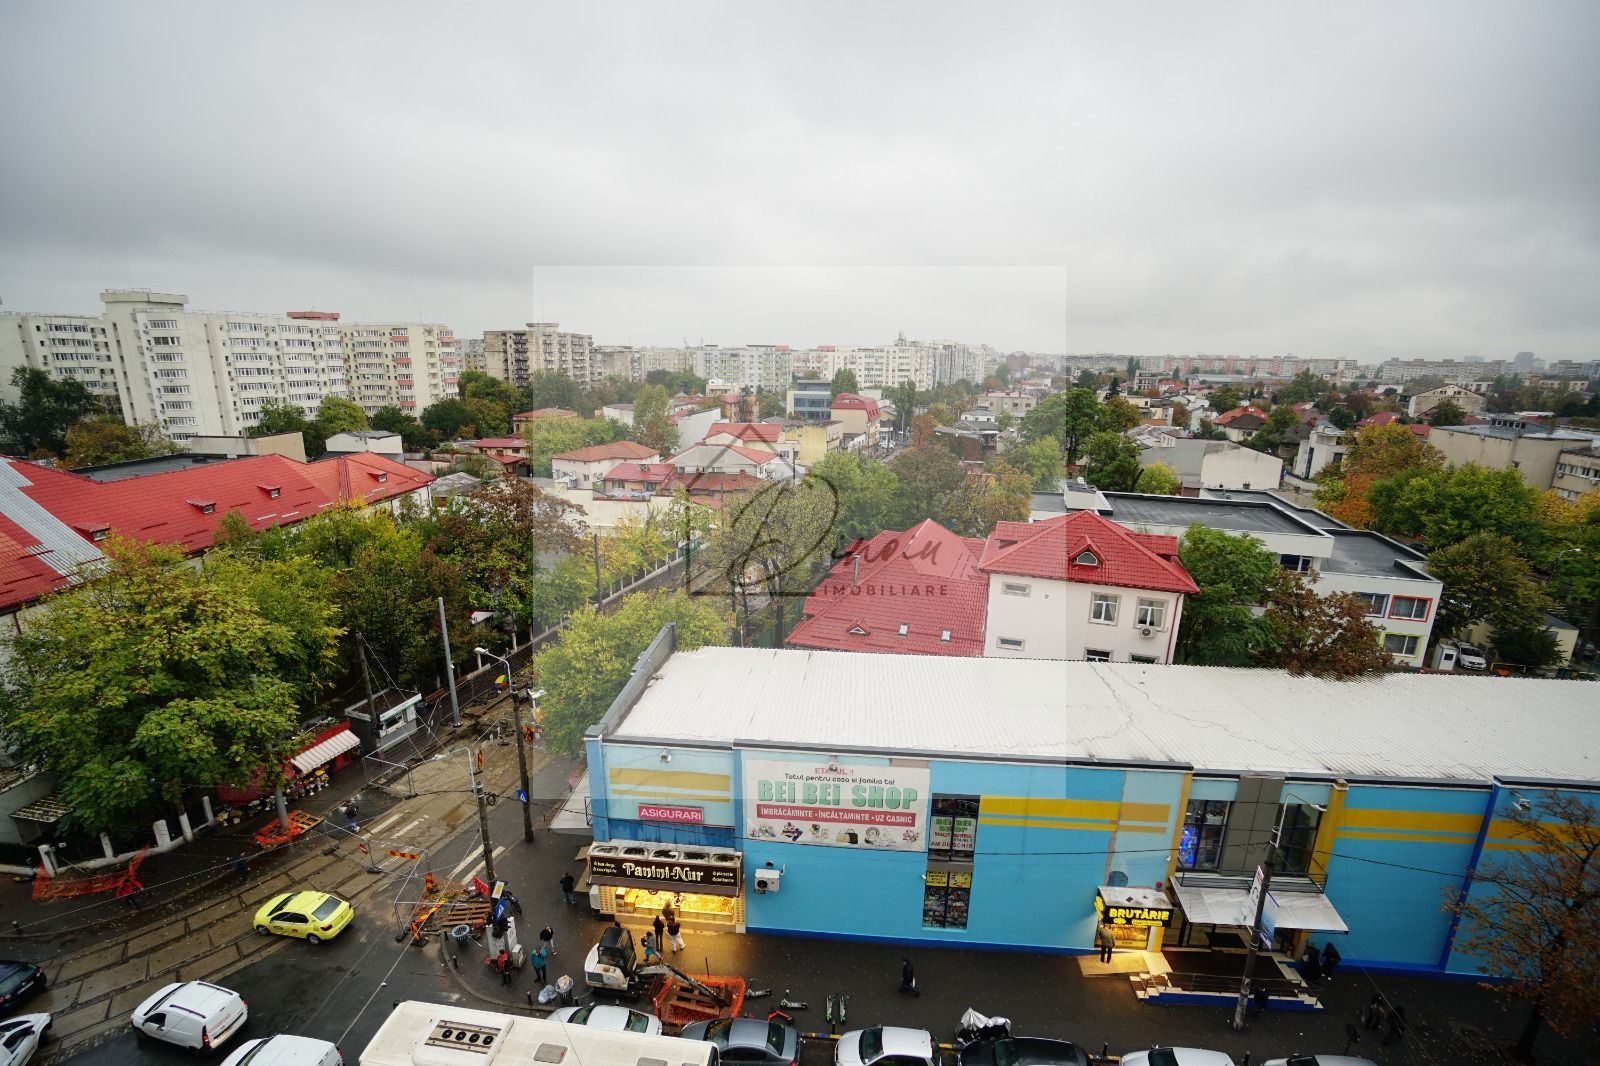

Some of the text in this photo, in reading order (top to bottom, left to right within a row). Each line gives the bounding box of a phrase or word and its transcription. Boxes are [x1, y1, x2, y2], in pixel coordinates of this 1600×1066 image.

[815, 767, 847, 775] ETAUL
[851, 784, 918, 809] SHOP
[641, 808, 701, 820] ASIGURARI
[875, 814, 885, 822] UZ
[886, 814, 913, 824] CASNIC
